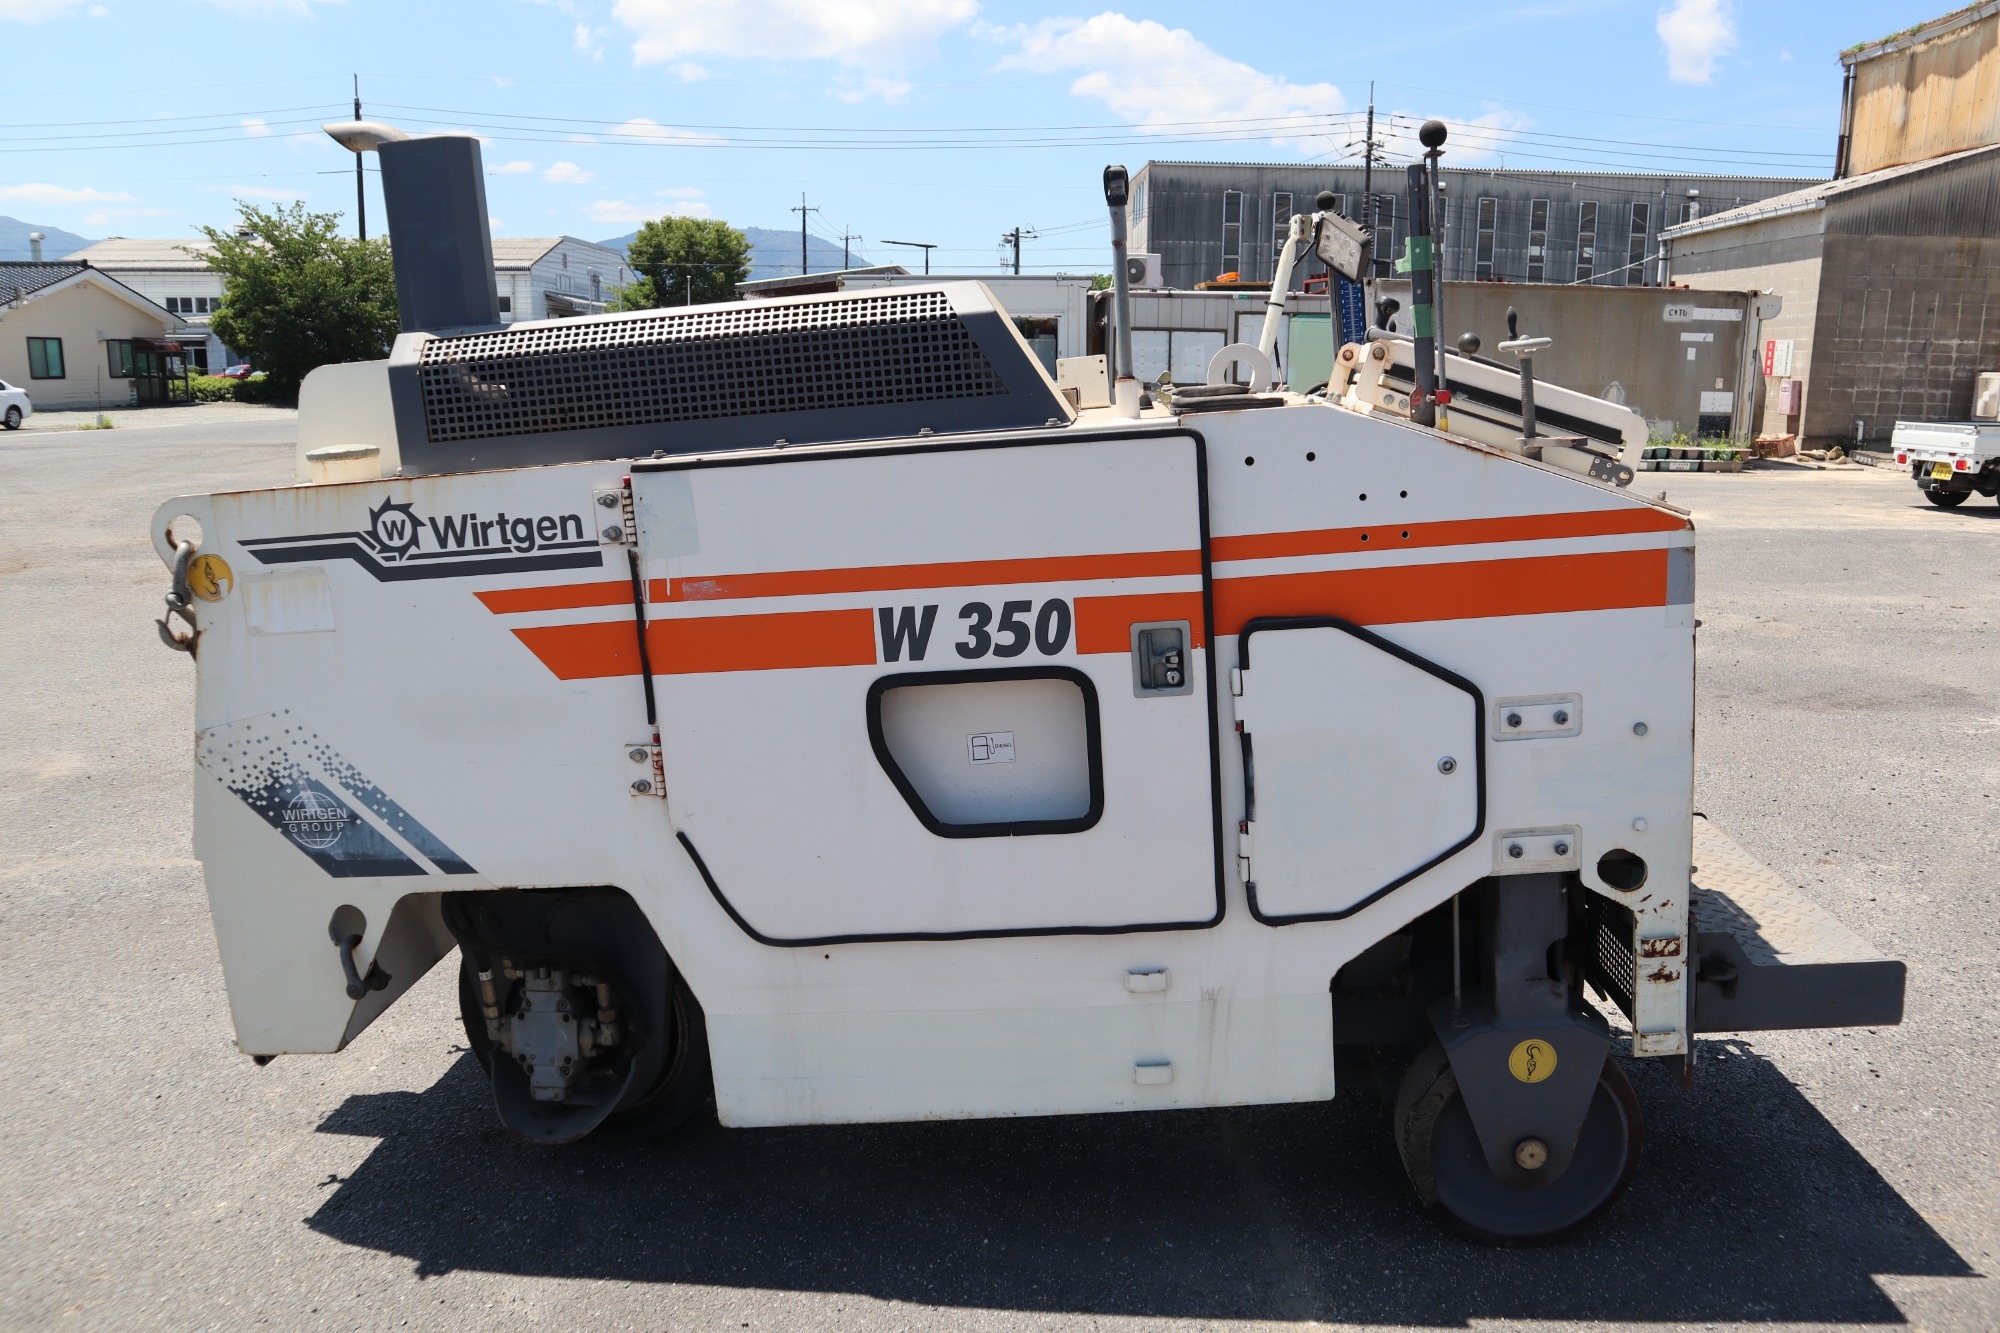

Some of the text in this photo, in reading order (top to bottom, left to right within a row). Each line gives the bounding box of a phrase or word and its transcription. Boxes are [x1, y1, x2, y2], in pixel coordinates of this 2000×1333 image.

[428, 512, 584, 554] Wirtgen
[878, 598, 1072, 663] W 350
[282, 808, 347, 820] WIRTGEN
[289, 822, 344, 833] GROUP
